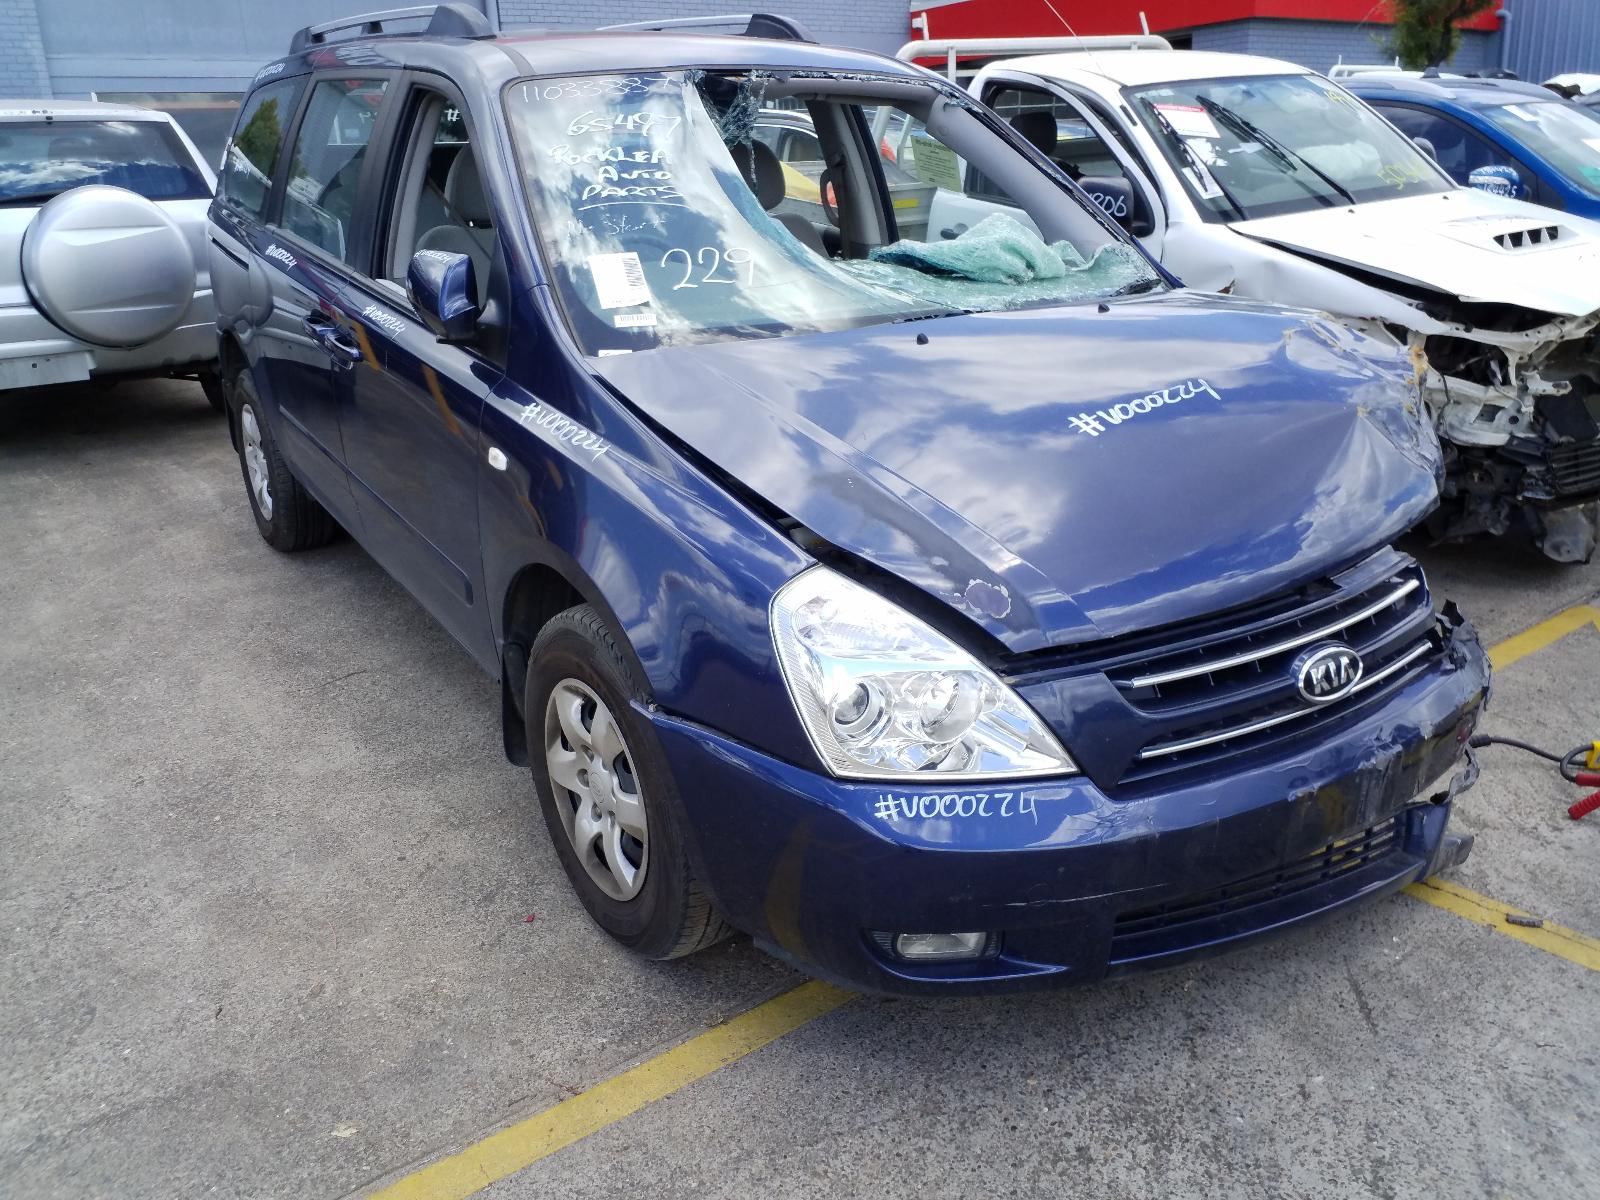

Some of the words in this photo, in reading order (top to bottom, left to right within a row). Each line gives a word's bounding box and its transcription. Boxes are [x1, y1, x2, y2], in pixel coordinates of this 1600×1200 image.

[582, 184, 684, 200] PARTS
[660, 247, 753, 290] 229
[1309, 655, 1356, 695] KIA
